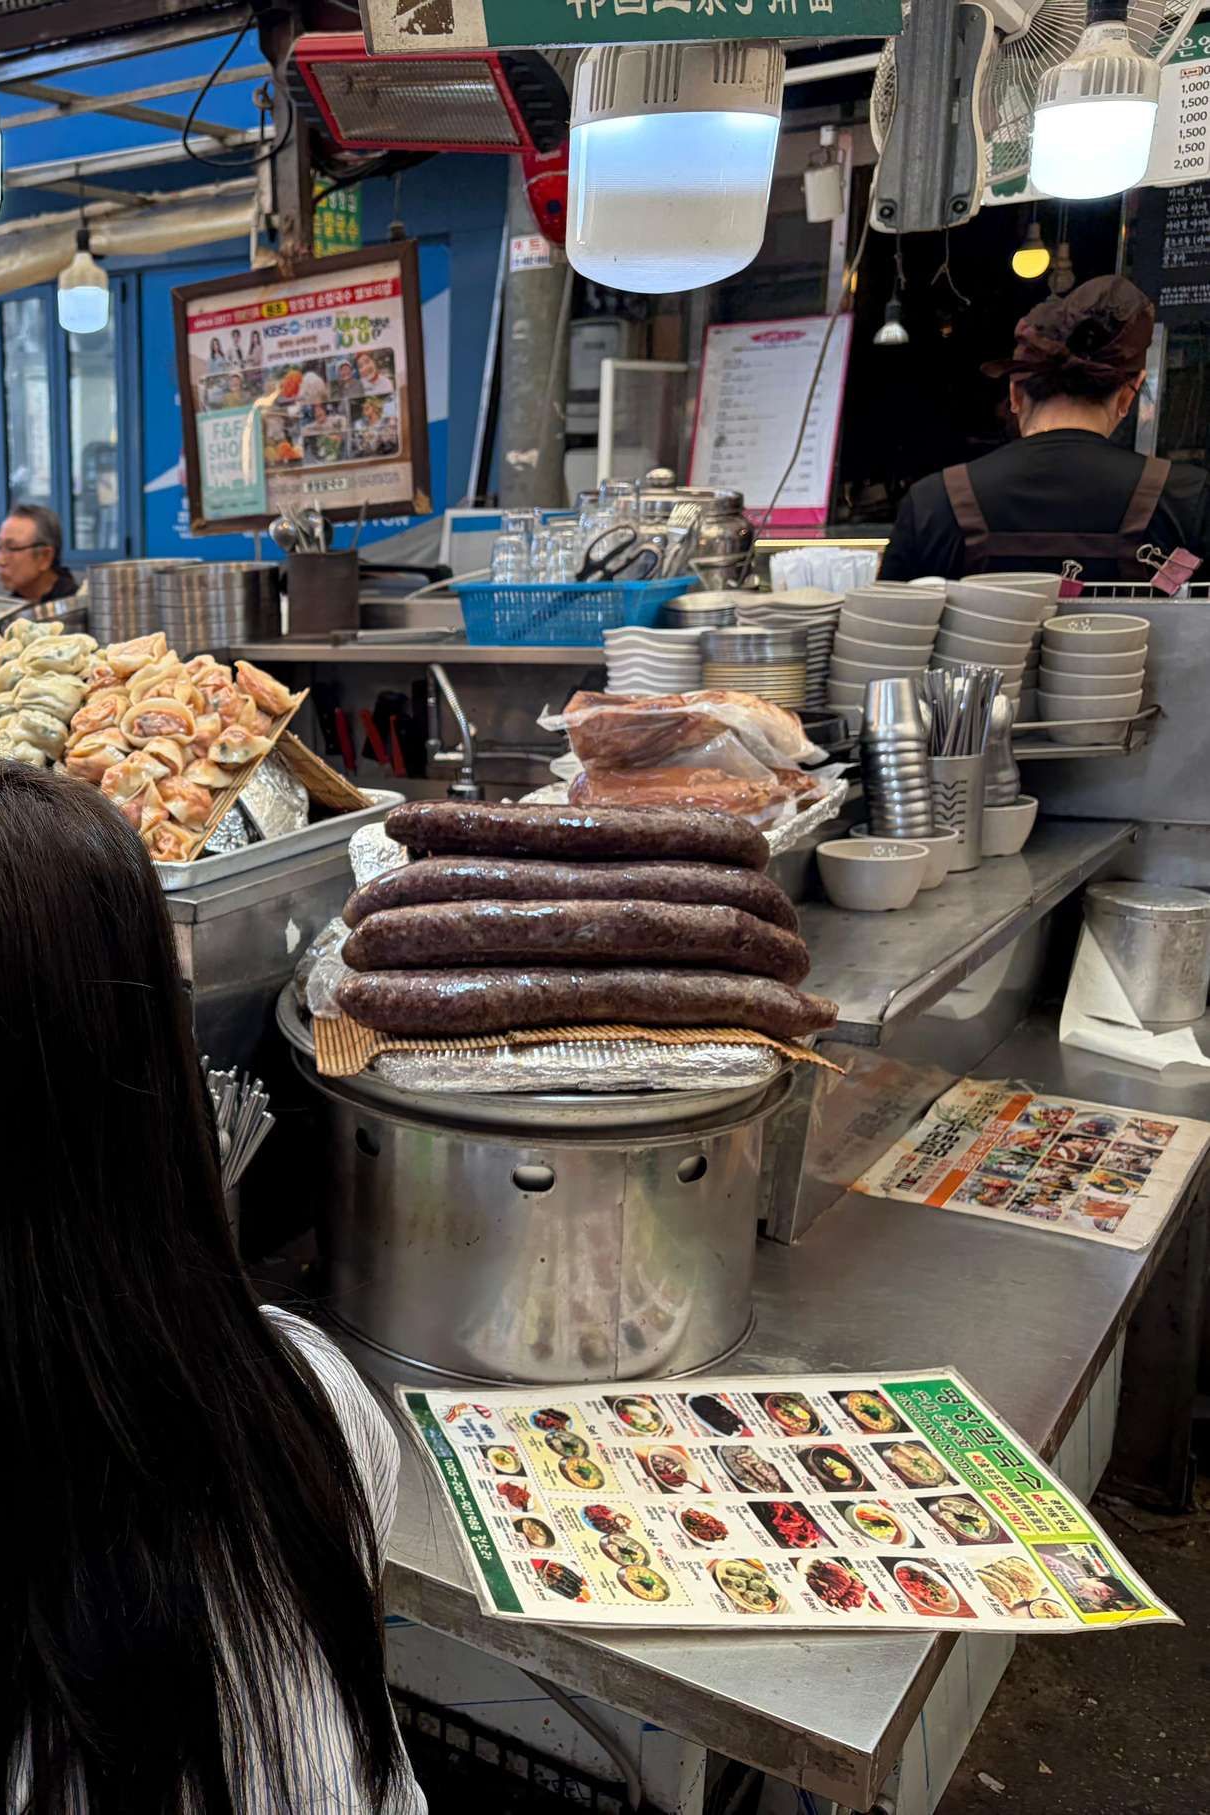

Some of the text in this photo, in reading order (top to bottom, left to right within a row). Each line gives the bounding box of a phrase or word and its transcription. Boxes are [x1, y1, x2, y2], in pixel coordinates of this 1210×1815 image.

[1181, 80, 1209, 95] 1,000
[1181, 96, 1208, 110] 1,500
[1180, 111, 1207, 125] 1,000
[1179, 126, 1206, 140] 1,500
[1178, 141, 1205, 155] 1,500
[1174, 156, 1204, 170] 2,000
[263, 322, 289, 339] KBS
[213, 420, 243, 440] F&F
[209, 440, 239, 461] SHO
[584, 1424, 600, 1435] Set
[934, 1387, 1043, 1491] 평창칼국수
[942, 1445, 986, 1487] NOODLES
[442, 1458, 496, 1560] 1005-202-901988 정소라
[987, 1491, 1031, 1533] since 1977
[1052, 1518, 1071, 1533] 맛집
[642, 1528, 660, 1540] Set
